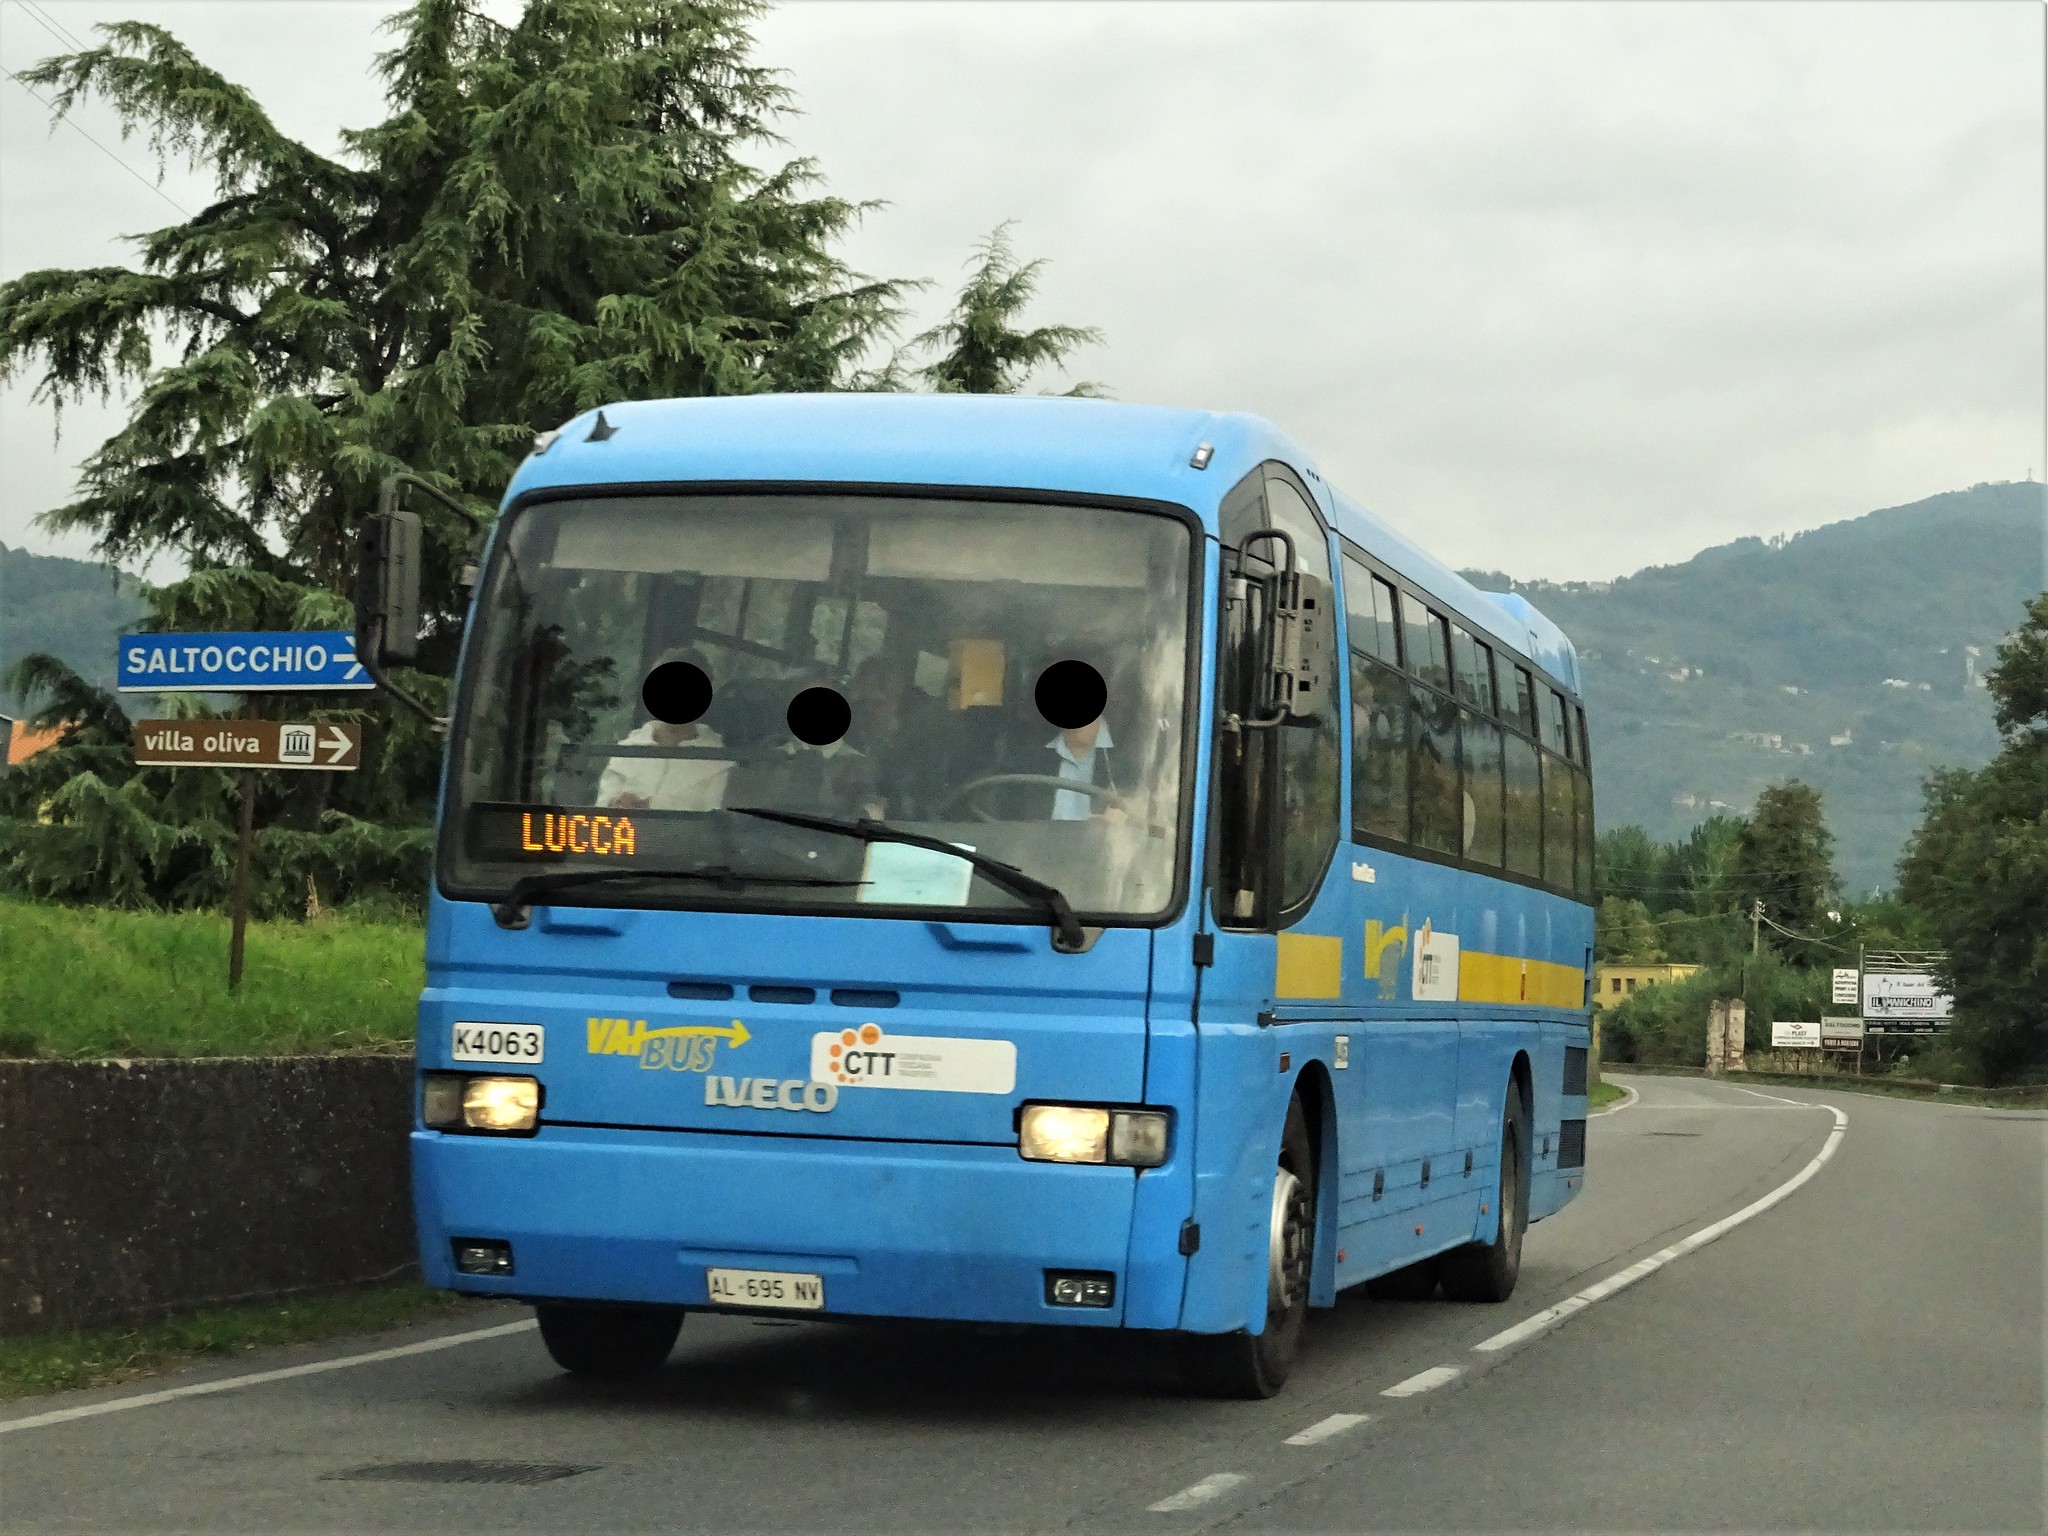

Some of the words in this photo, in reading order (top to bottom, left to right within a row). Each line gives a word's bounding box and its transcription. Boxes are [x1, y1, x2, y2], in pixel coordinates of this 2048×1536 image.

[126, 645, 327, 674] SALTOCCHIO
[144, 730, 194, 752] villa
[203, 731, 260, 753] oliva
[522, 812, 635, 856] LUCCA
[455, 1028, 539, 1057] K4063
[844, 1050, 896, 1076] CTT
[704, 1075, 839, 1113] IVECO
